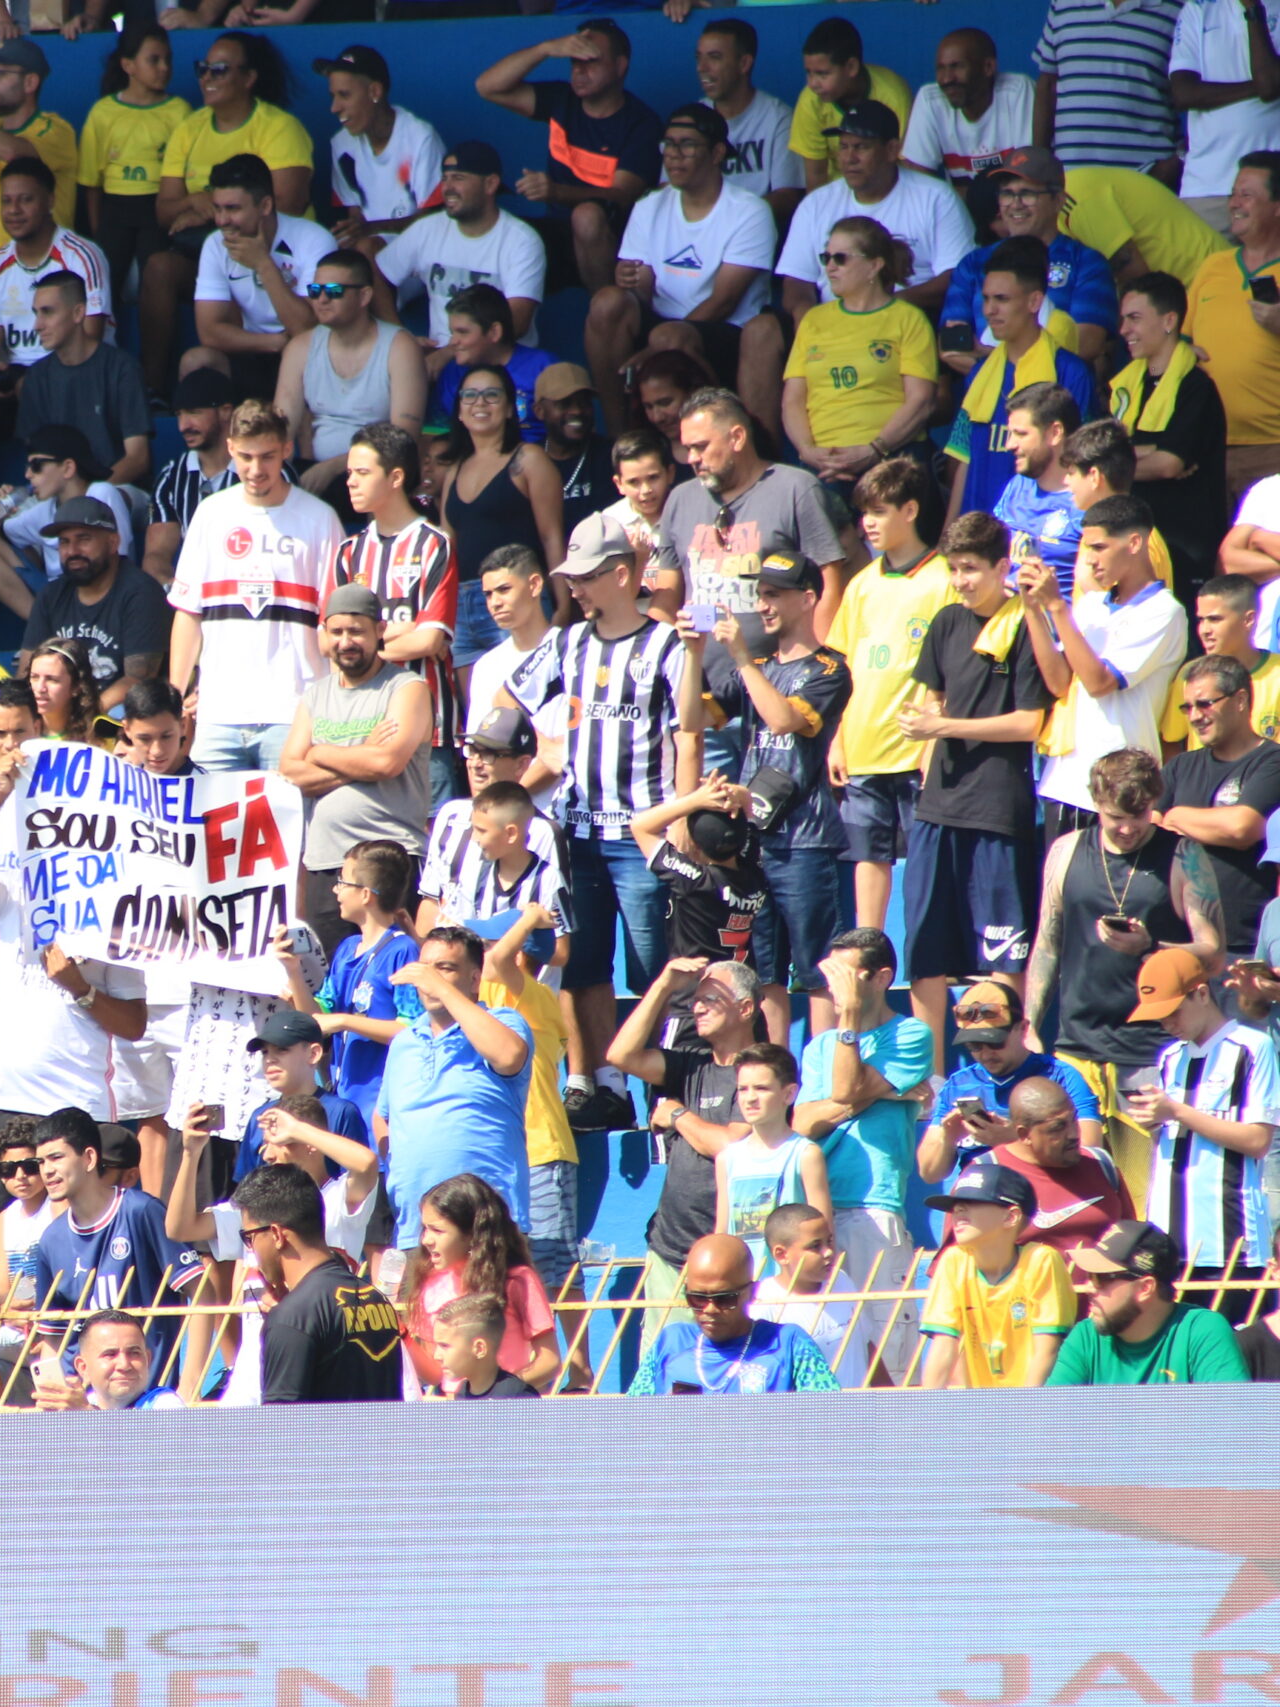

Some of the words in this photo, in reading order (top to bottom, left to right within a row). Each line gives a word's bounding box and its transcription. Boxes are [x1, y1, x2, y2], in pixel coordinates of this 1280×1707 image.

[830, 366, 858, 389] 10
[261, 533, 295, 556] LG
[76, 623, 114, 648] School
[867, 644, 891, 669] 10
[585, 702, 642, 721] BETANO
[26, 747, 93, 799] MC
[99, 755, 209, 825] HARIEL
[25, 806, 117, 852] SOU
[130, 819, 196, 868] SEU
[24, 851, 70, 902] ME
[672, 857, 702, 881] MRV
[31, 896, 103, 951] SUA
[107, 883, 288, 965] CAMISETA
[984, 925, 1015, 940] NIKE
[1009, 942, 1030, 960] SB
